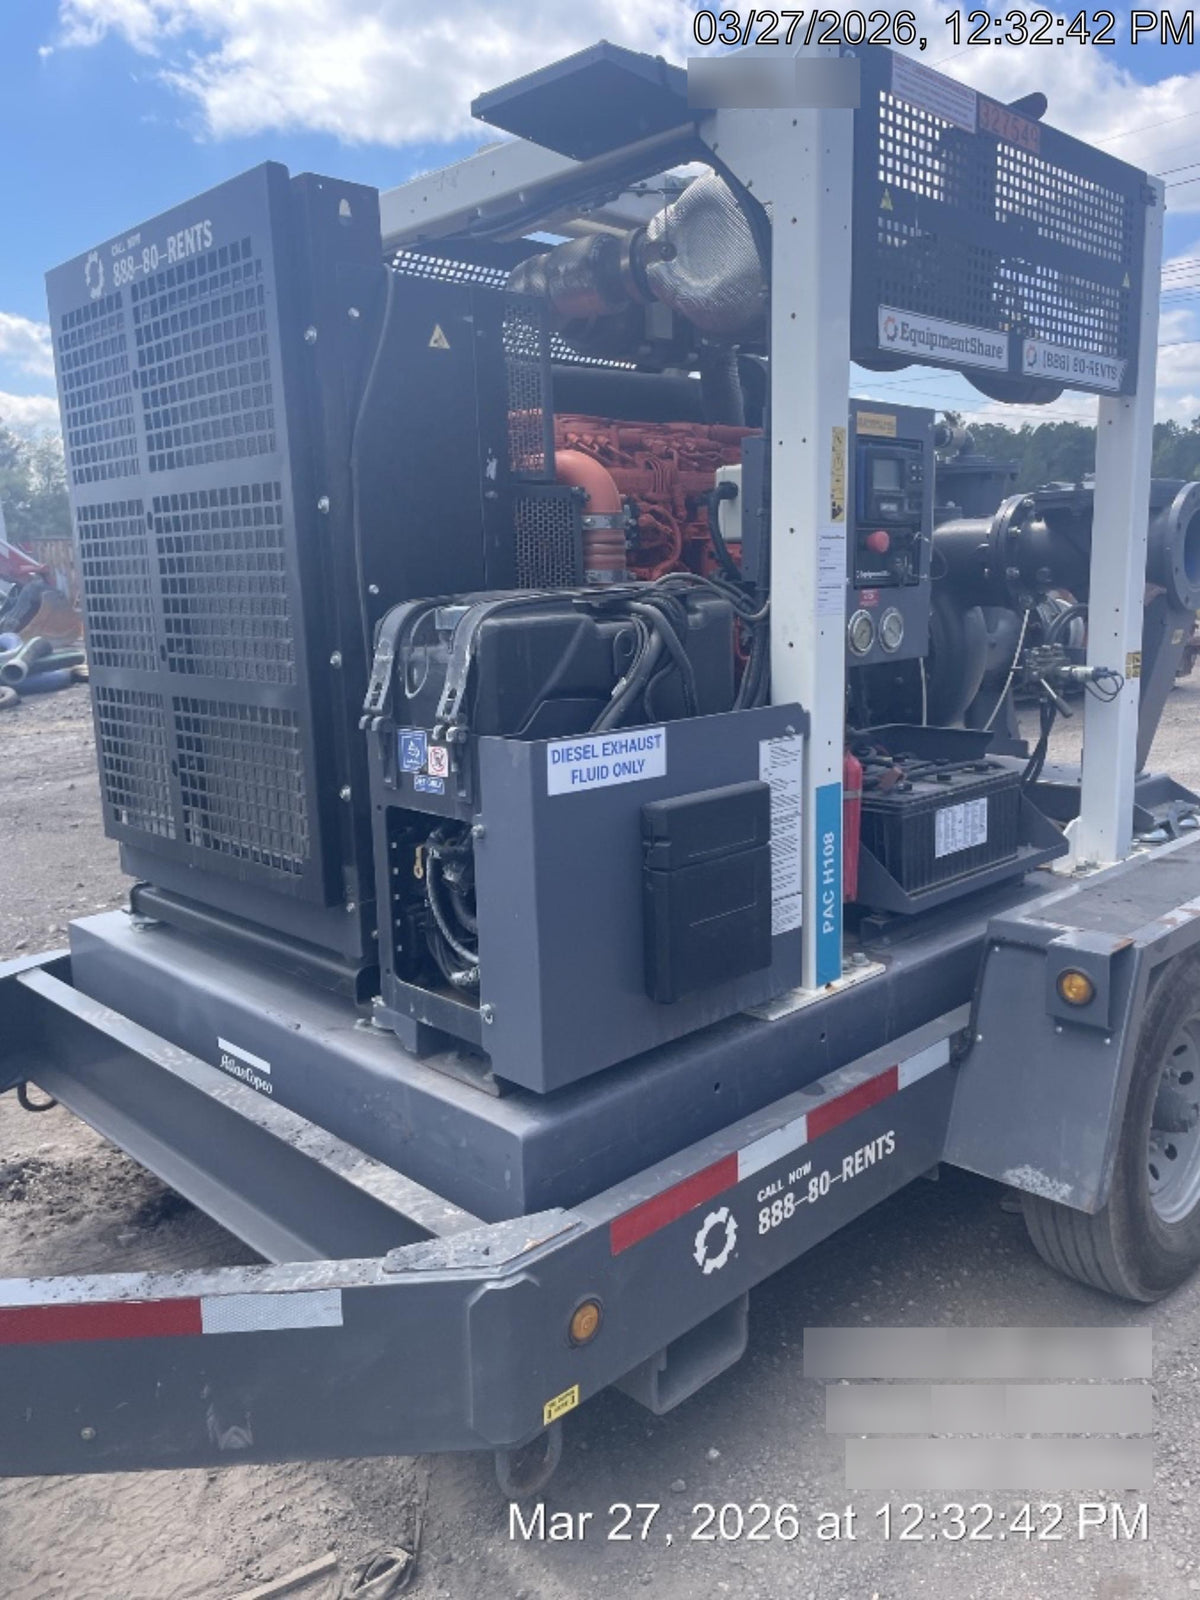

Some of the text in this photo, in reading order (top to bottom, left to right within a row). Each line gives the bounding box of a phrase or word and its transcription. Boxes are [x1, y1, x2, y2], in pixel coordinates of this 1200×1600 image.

[899, 320, 1004, 360] EquipmentShare
[1043, 349, 1118, 381] (888) 80-RENTS
[551, 734, 662, 765] DIESEL EXHAUST
[571, 758, 646, 785] FLUID ONLY
[822, 831, 835, 934] PAC H108
[757, 1160, 812, 1202] CALL NOW
